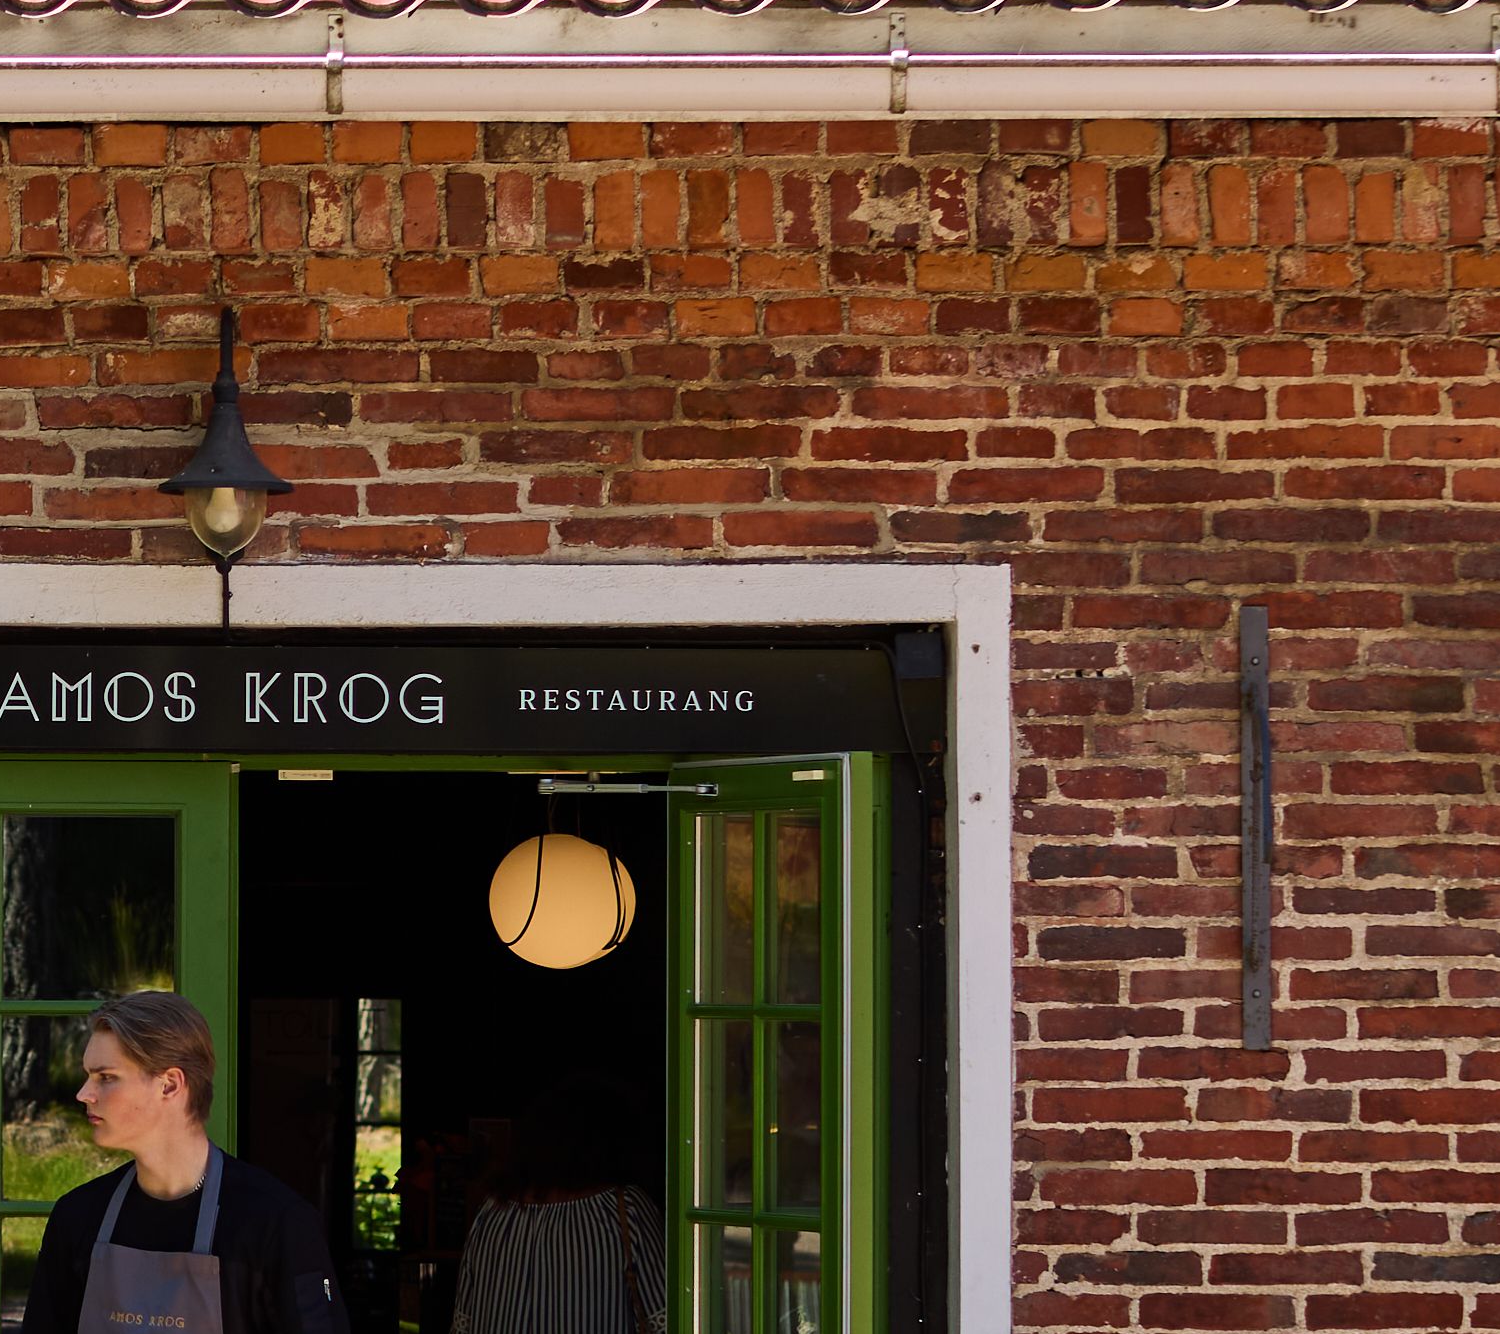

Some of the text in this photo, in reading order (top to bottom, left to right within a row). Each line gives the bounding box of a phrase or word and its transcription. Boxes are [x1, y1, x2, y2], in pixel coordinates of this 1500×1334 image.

[244, 671, 444, 724] KROG
[517, 688, 754, 712] RESTAURANG
[109, 1310, 143, 1325] AMOS
